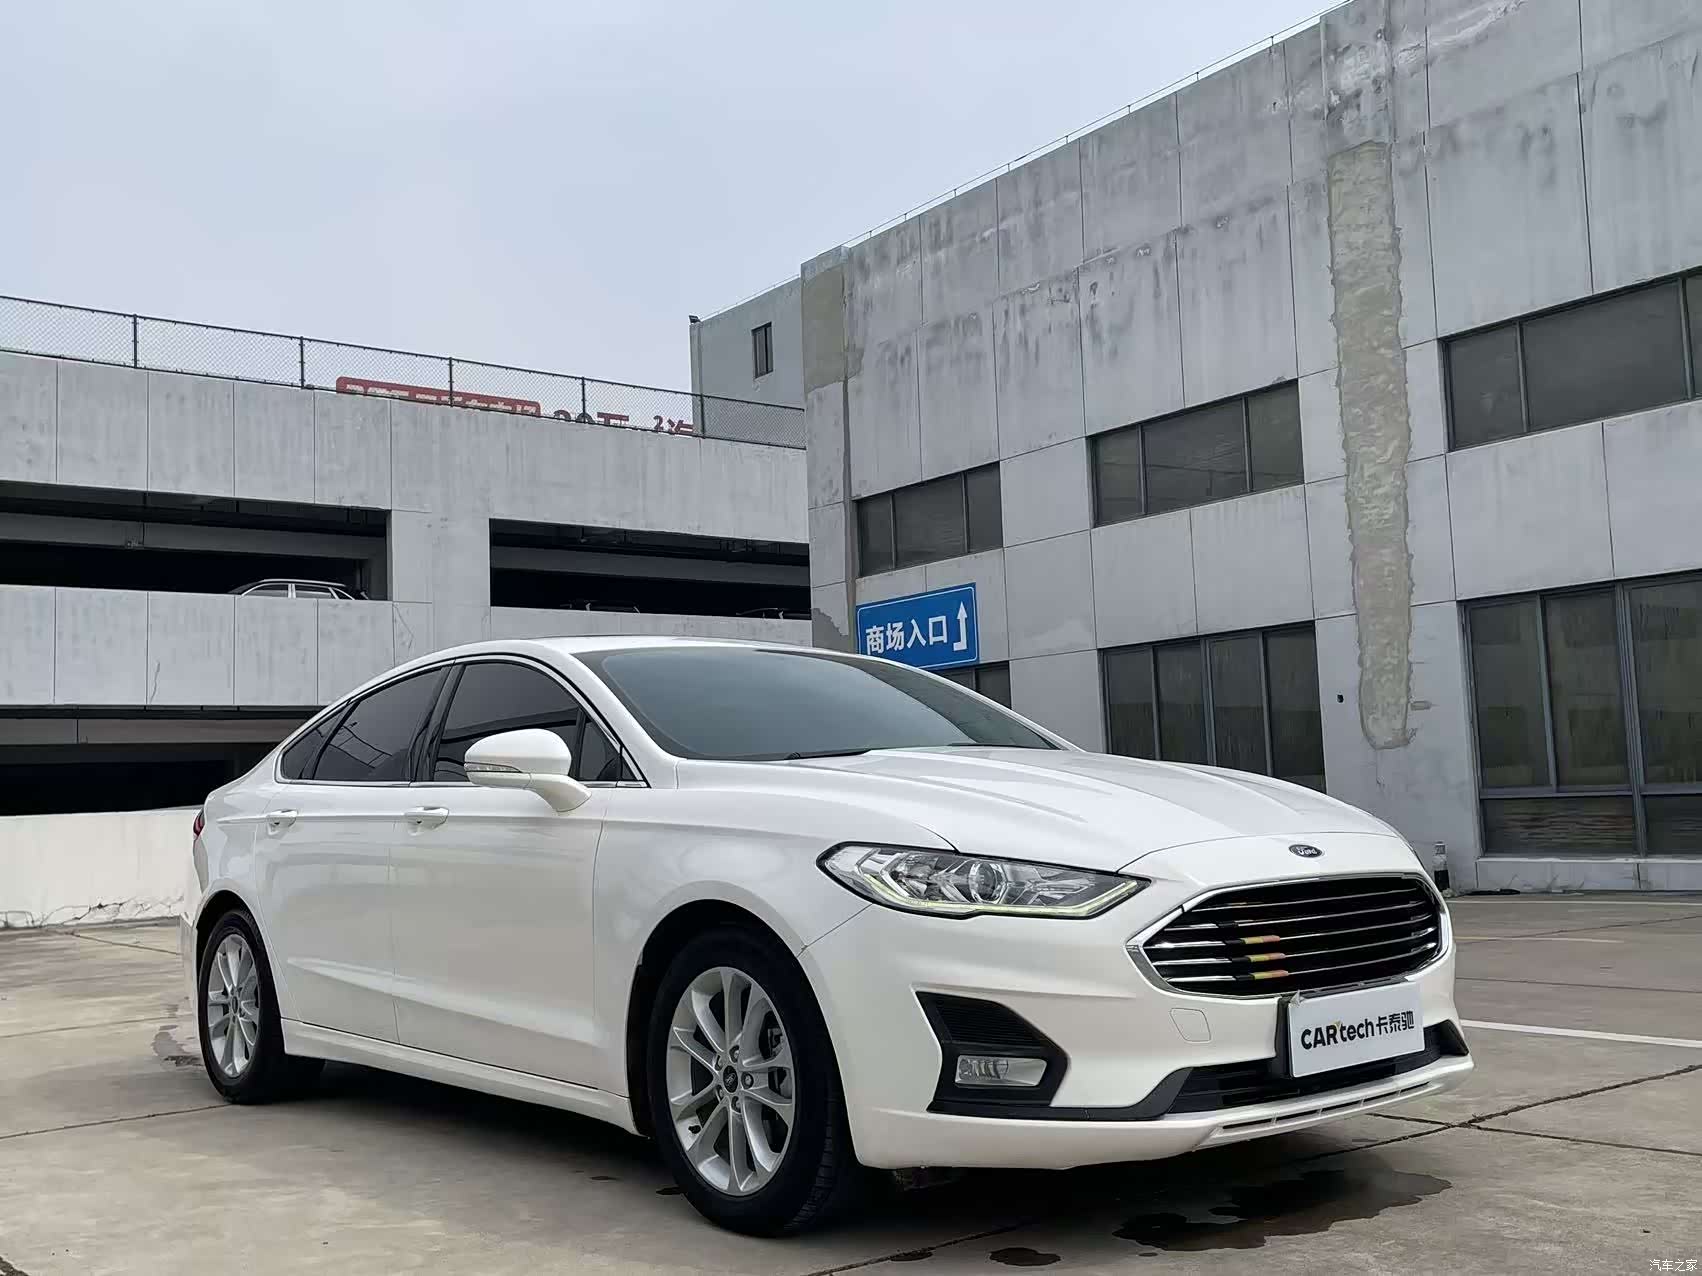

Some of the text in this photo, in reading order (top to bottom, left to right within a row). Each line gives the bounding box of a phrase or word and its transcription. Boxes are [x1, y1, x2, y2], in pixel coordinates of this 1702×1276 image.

[865, 615, 948, 656] 商场入口
[1376, 1010, 1415, 1036] 卡泰驰
